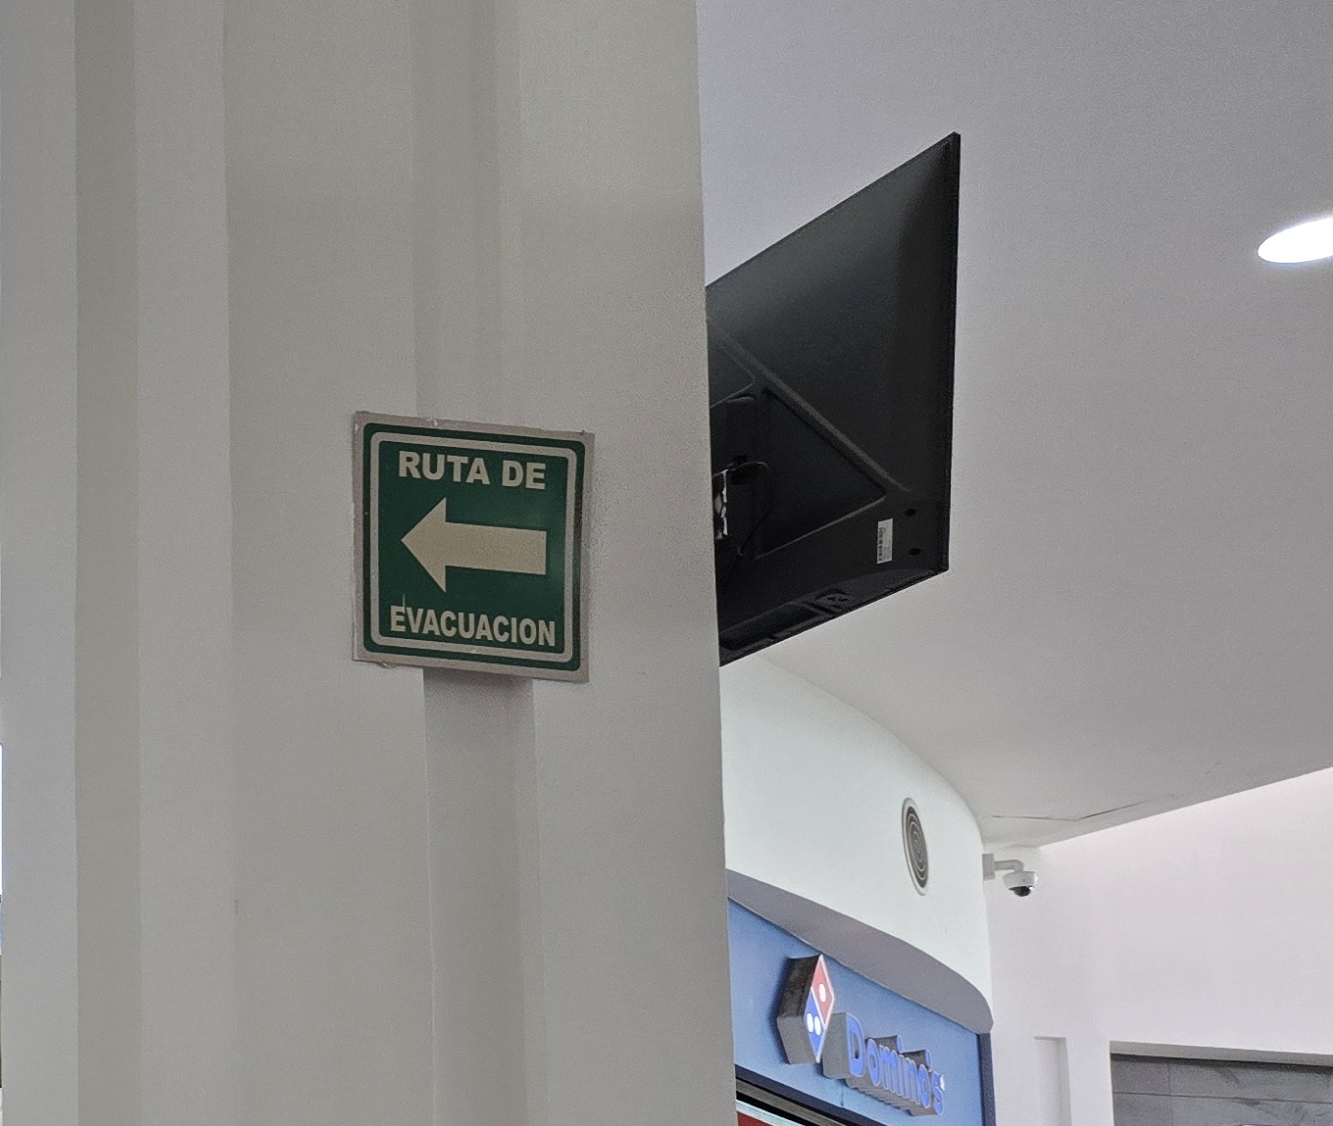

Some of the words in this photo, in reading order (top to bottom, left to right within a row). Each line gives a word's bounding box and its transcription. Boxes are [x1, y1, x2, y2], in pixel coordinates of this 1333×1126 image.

[398, 450, 490, 485] RUTA
[502, 459, 546, 490] DE
[390, 604, 556, 647] EVACUACION
